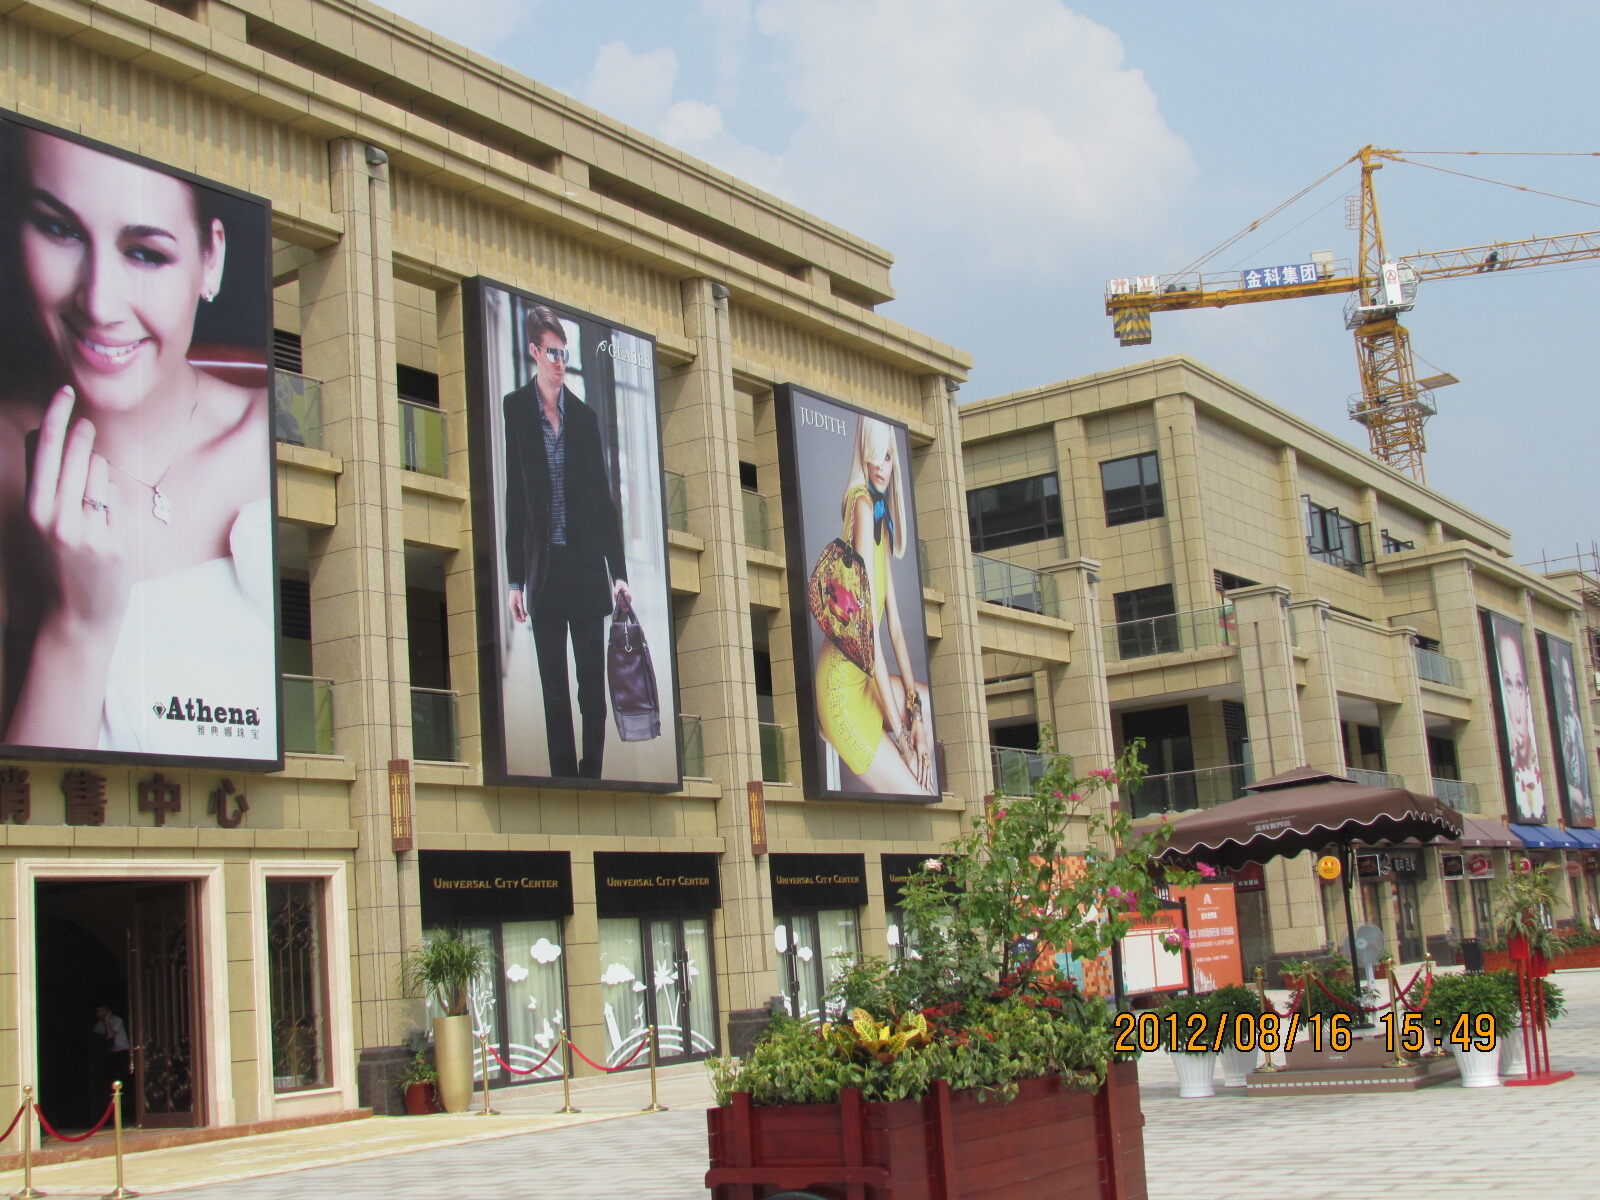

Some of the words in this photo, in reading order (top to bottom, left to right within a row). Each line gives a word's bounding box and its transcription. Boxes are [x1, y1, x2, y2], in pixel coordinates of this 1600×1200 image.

[1246, 263, 1317, 288] 金科集团
[800, 406, 847, 436] JUDITH
[166, 696, 260, 726] Athena
[433, 878, 492, 889] UNIVERSAL
[494, 877, 519, 889] CITY
[521, 877, 559, 889] CENTER
[606, 877, 654, 887] UNIVERSAL
[656, 876, 676, 886] CITY
[678, 876, 710, 886] CENTER
[776, 875, 815, 885] UNIVERSAL
[815, 874, 832, 884] CITY
[833, 874, 860, 884] CENTER
